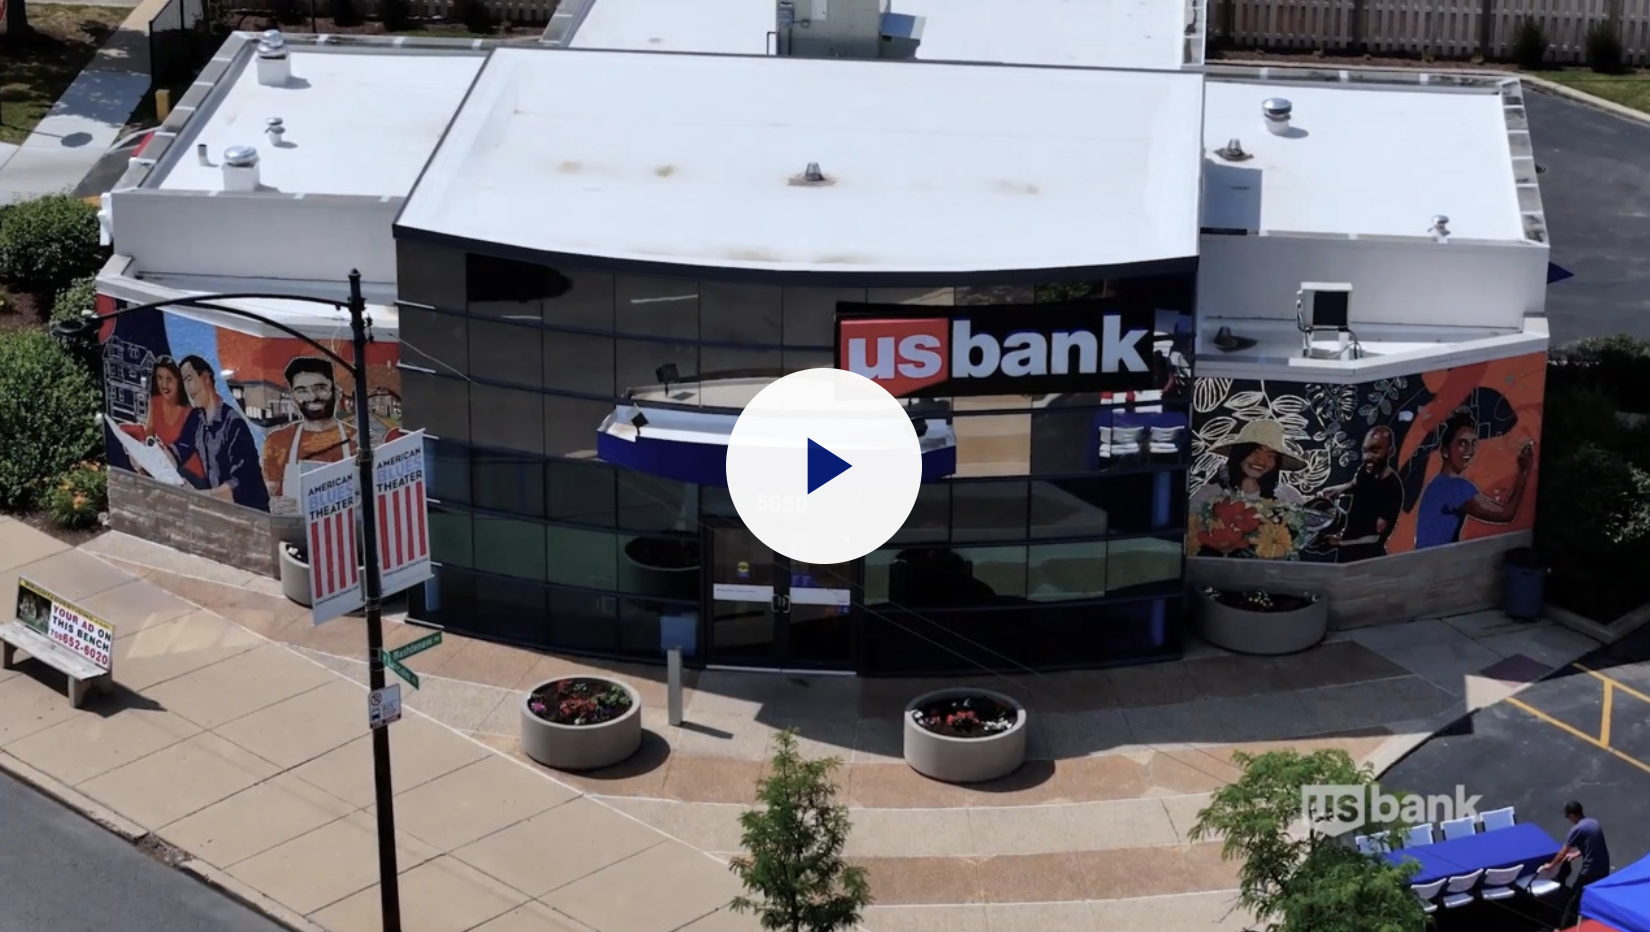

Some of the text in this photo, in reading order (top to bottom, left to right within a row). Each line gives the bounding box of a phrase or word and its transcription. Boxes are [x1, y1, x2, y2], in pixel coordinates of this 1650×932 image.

[376, 446, 421, 470] AMERICAN
[376, 457, 422, 482] BLUES
[308, 473, 353, 497] AMERICAN
[376, 470, 423, 493] THEATER
[308, 482, 354, 510] BLUES
[756, 493, 808, 513] 5650
[309, 497, 354, 521] THEATER
[52, 616, 110, 653] THIS BENCH
[53, 604, 111, 642] YOUR AD ON
